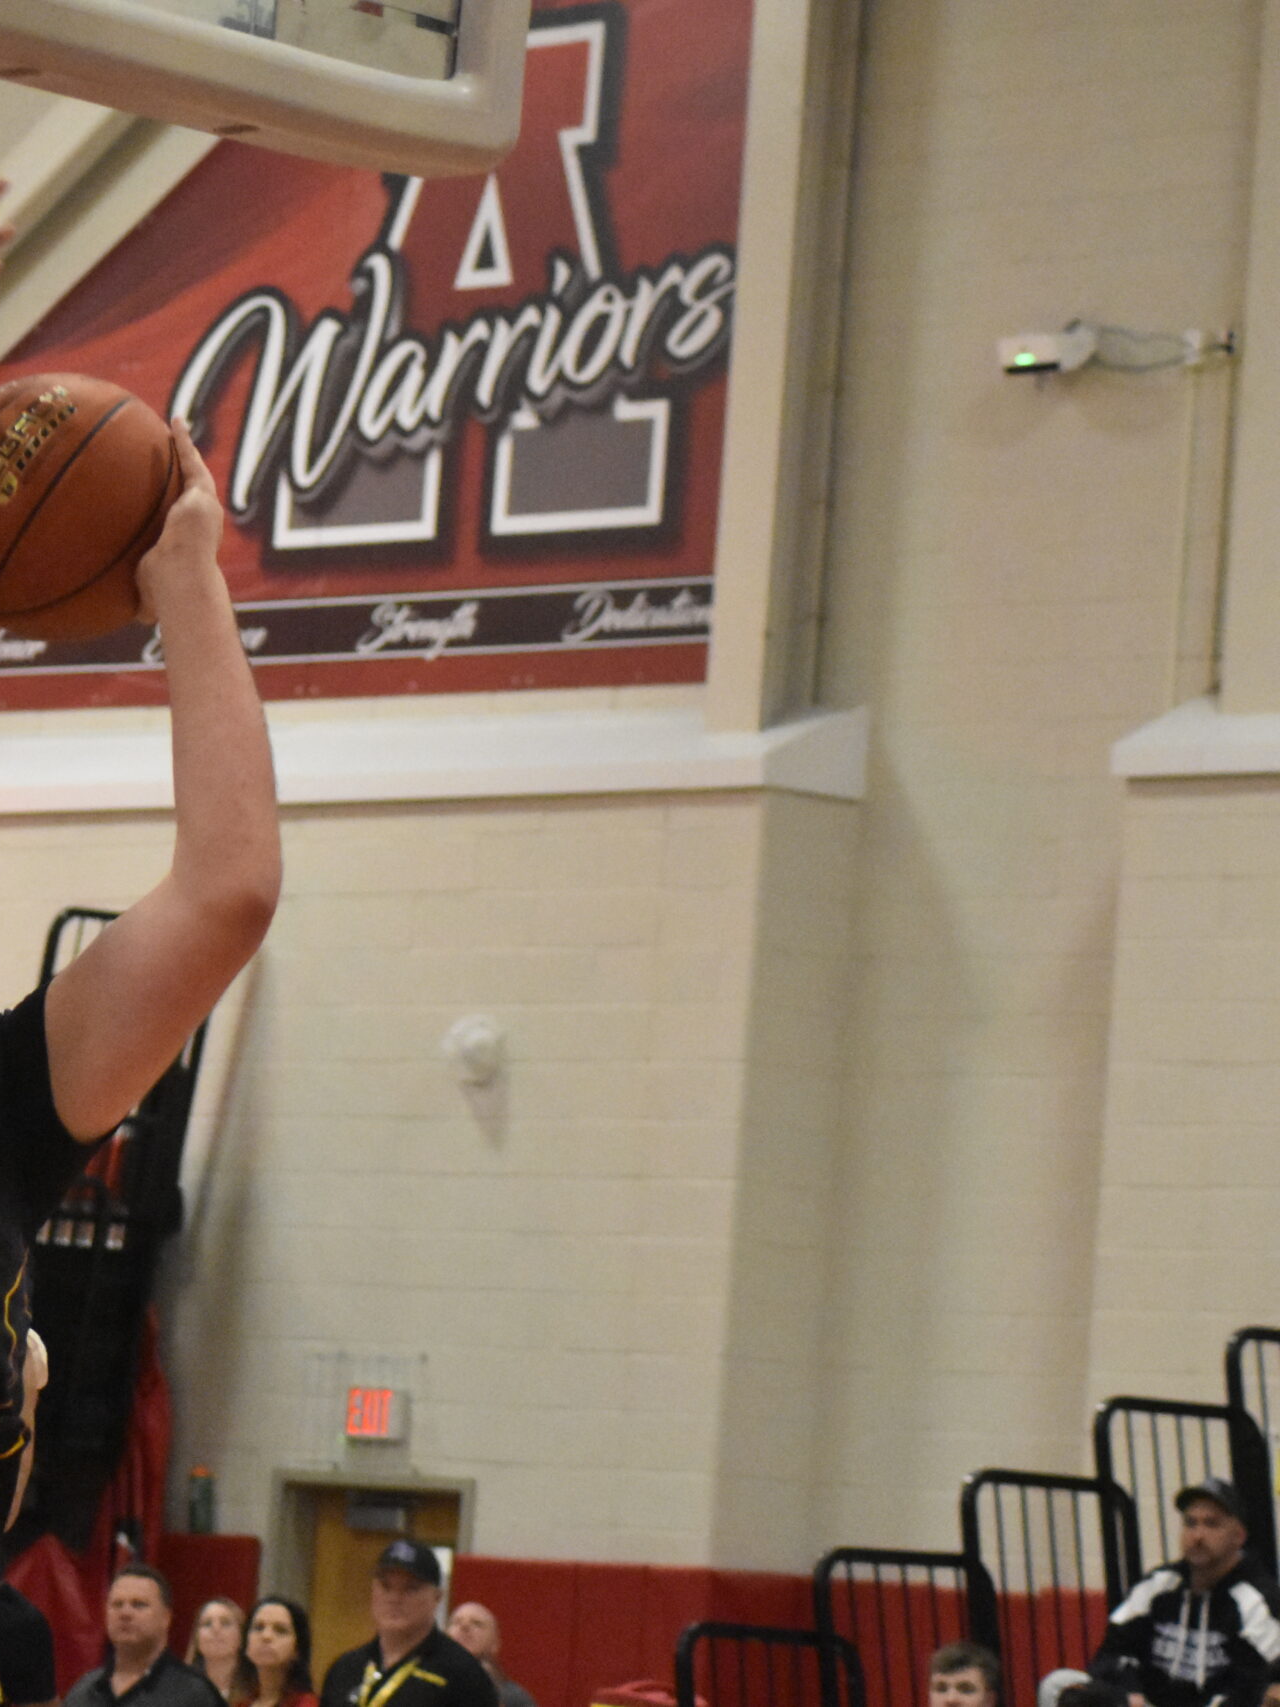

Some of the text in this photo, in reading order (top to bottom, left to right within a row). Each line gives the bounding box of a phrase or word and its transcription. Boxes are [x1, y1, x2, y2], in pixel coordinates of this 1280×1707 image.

[170, 252, 738, 514] Warriors
[354, 600, 480, 662] Strength
[346, 1387, 394, 1437] EXIT
